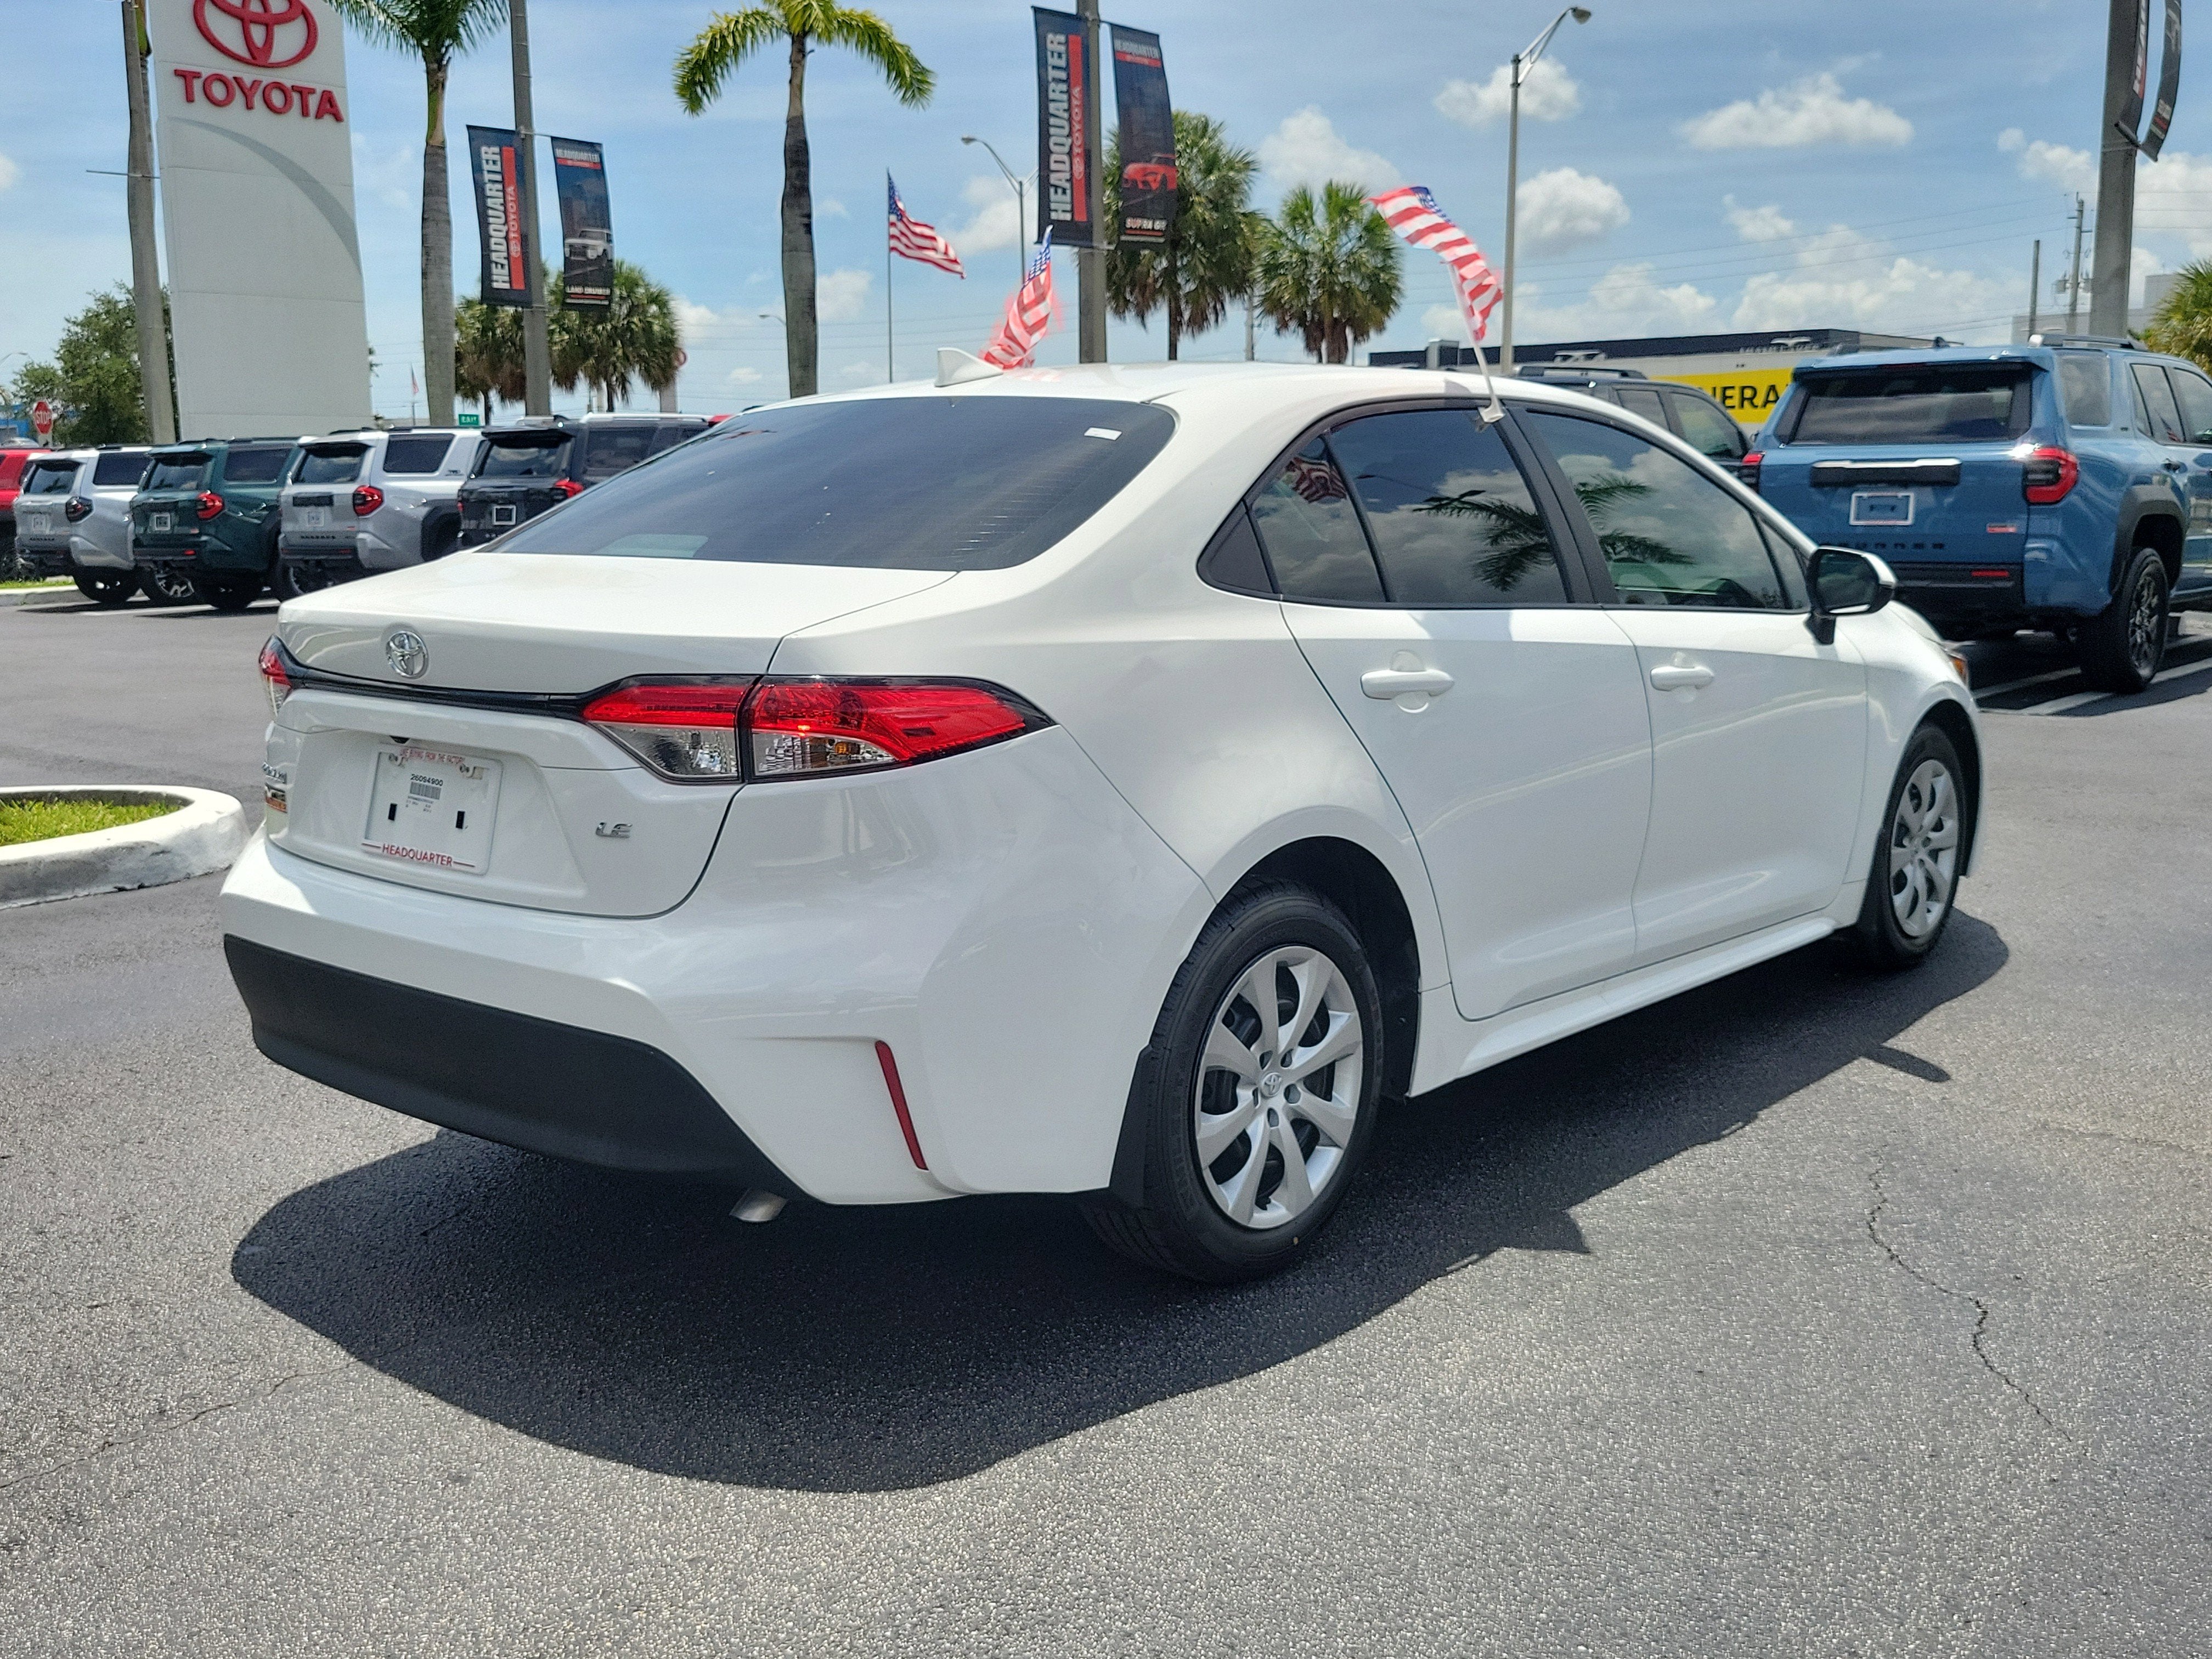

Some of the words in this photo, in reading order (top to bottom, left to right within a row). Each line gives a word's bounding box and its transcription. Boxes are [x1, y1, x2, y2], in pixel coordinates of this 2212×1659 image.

[174, 69, 344, 122] TOYOTA
[1046, 32, 1073, 221] HEADQUARTER
[1072, 86, 1085, 155] TOYOTA
[481, 146, 511, 289] HEADQUARTER
[506, 185, 518, 239] TOYOTA
[1125, 216, 1153, 230] SUPRA
[1711, 383, 1788, 409] ERA
[35, 410, 52, 424] STOP
[595, 822, 633, 839] LE
[382, 843, 453, 867] HEADQUARTER
